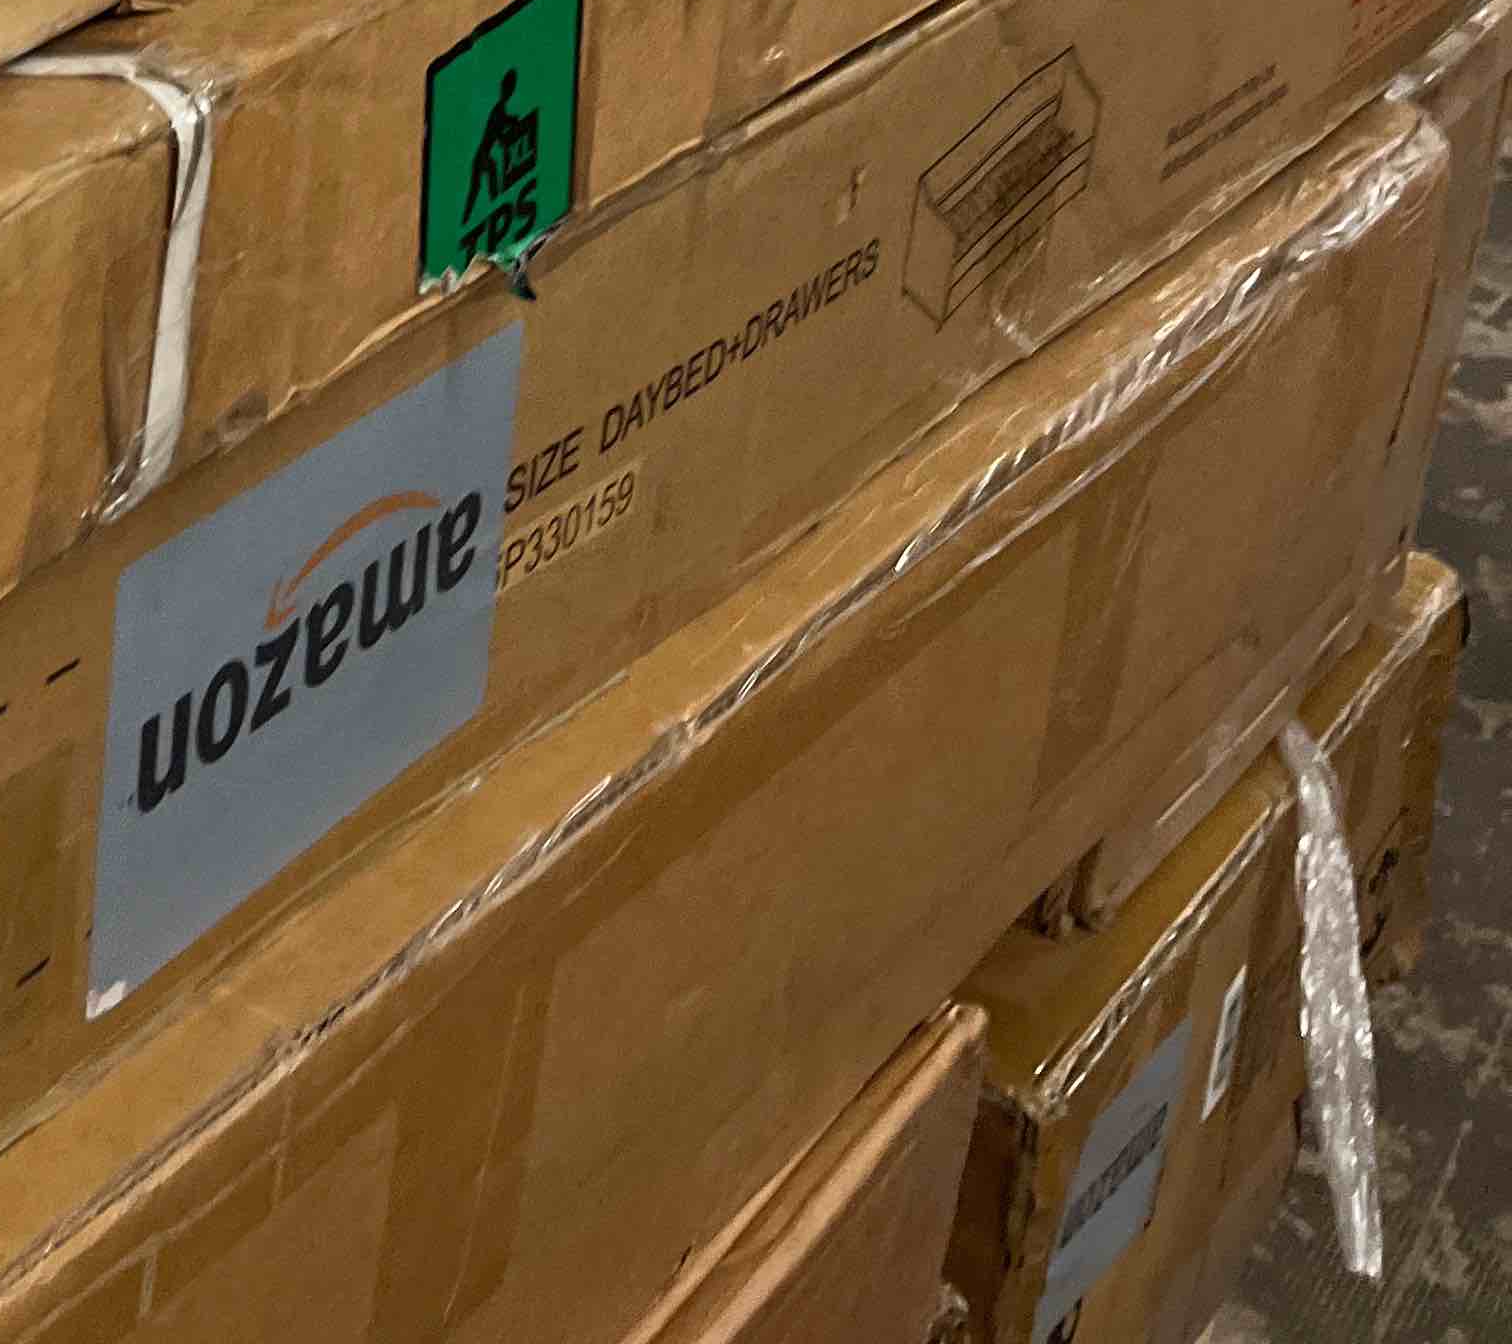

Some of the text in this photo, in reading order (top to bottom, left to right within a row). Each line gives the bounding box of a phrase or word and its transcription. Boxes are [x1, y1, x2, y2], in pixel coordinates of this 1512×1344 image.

[503, 236, 880, 514] SIZE DAYBED+DRAWERS
[135, 486, 483, 815] amazon
[496, 470, 636, 595] P330159
